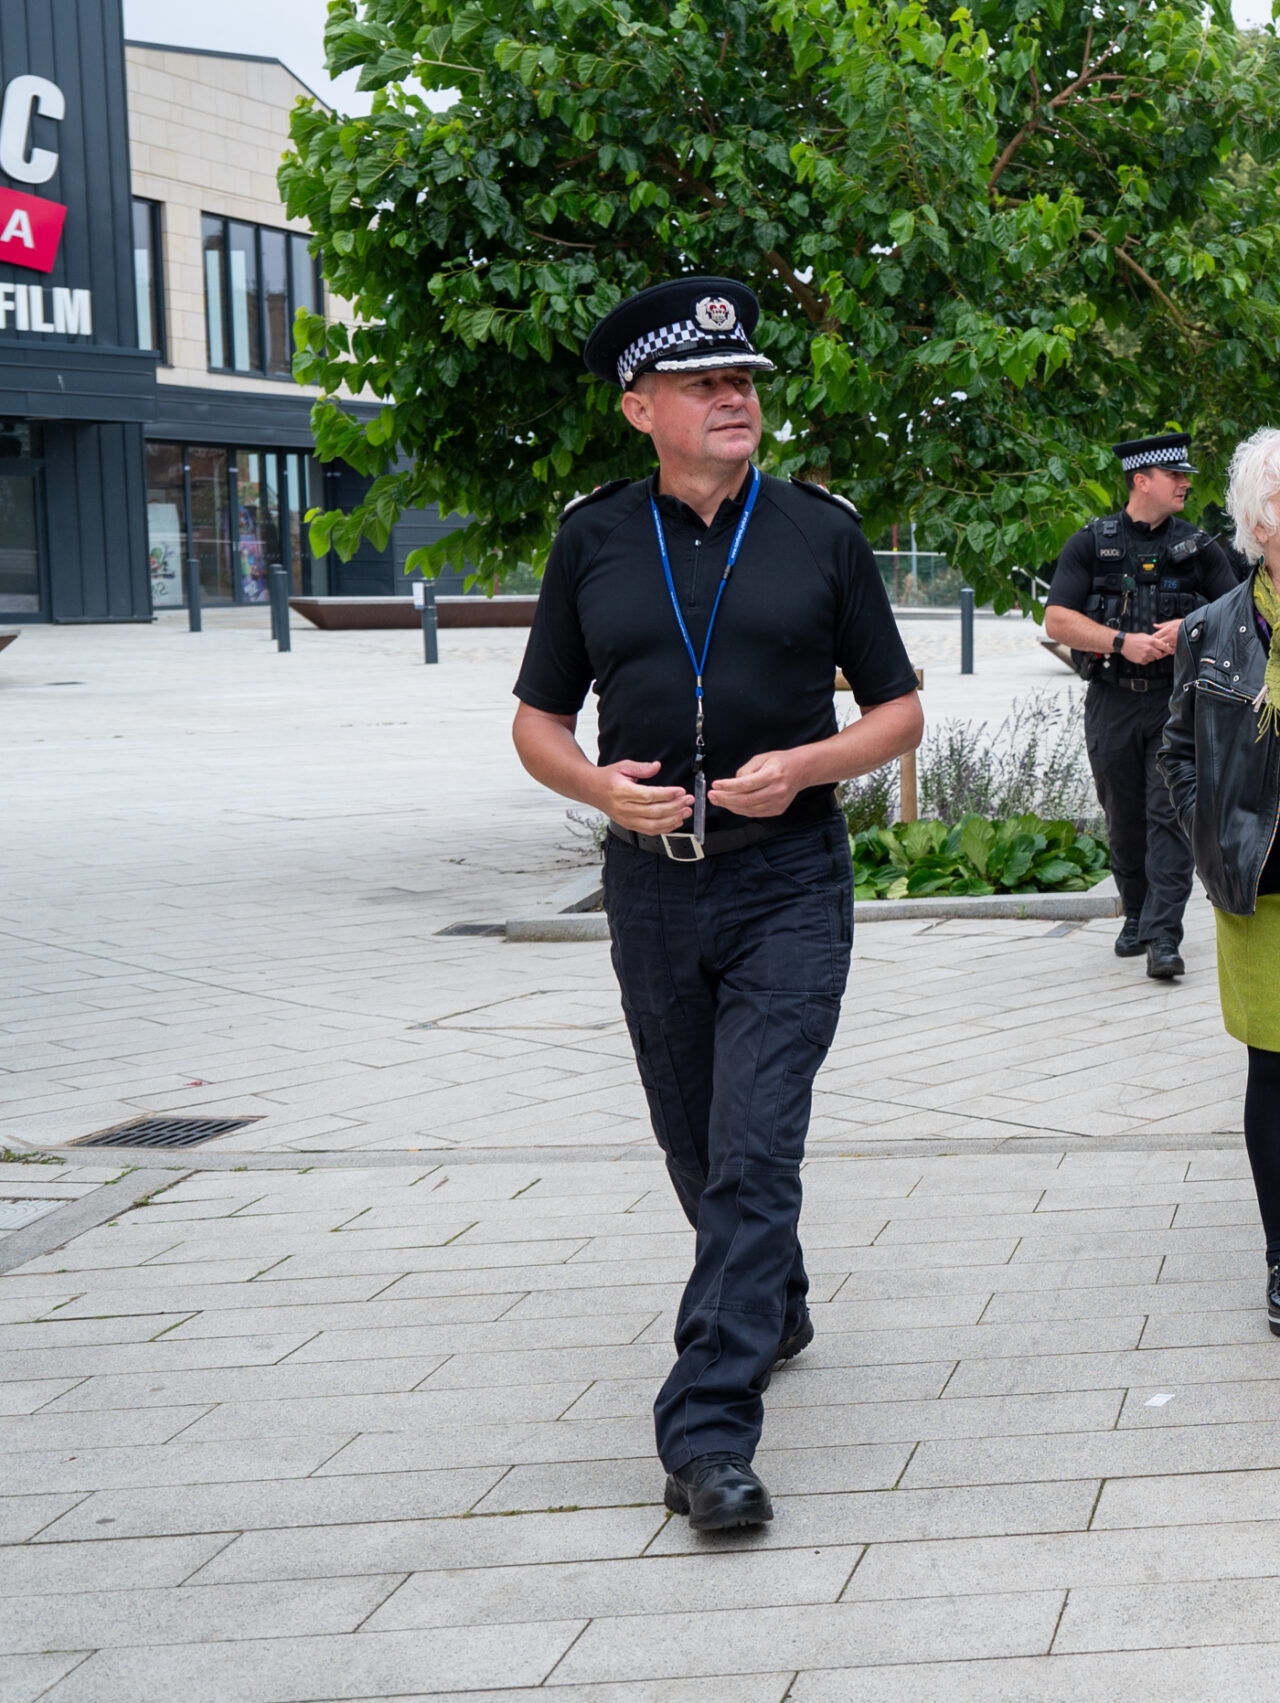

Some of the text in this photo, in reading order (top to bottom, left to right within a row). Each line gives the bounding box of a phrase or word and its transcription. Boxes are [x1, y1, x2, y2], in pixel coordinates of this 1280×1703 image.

[0, 75, 65, 184] C
[1, 209, 35, 249] A
[0, 282, 92, 336] FILM
[1100, 548, 1120, 557] POLICE
